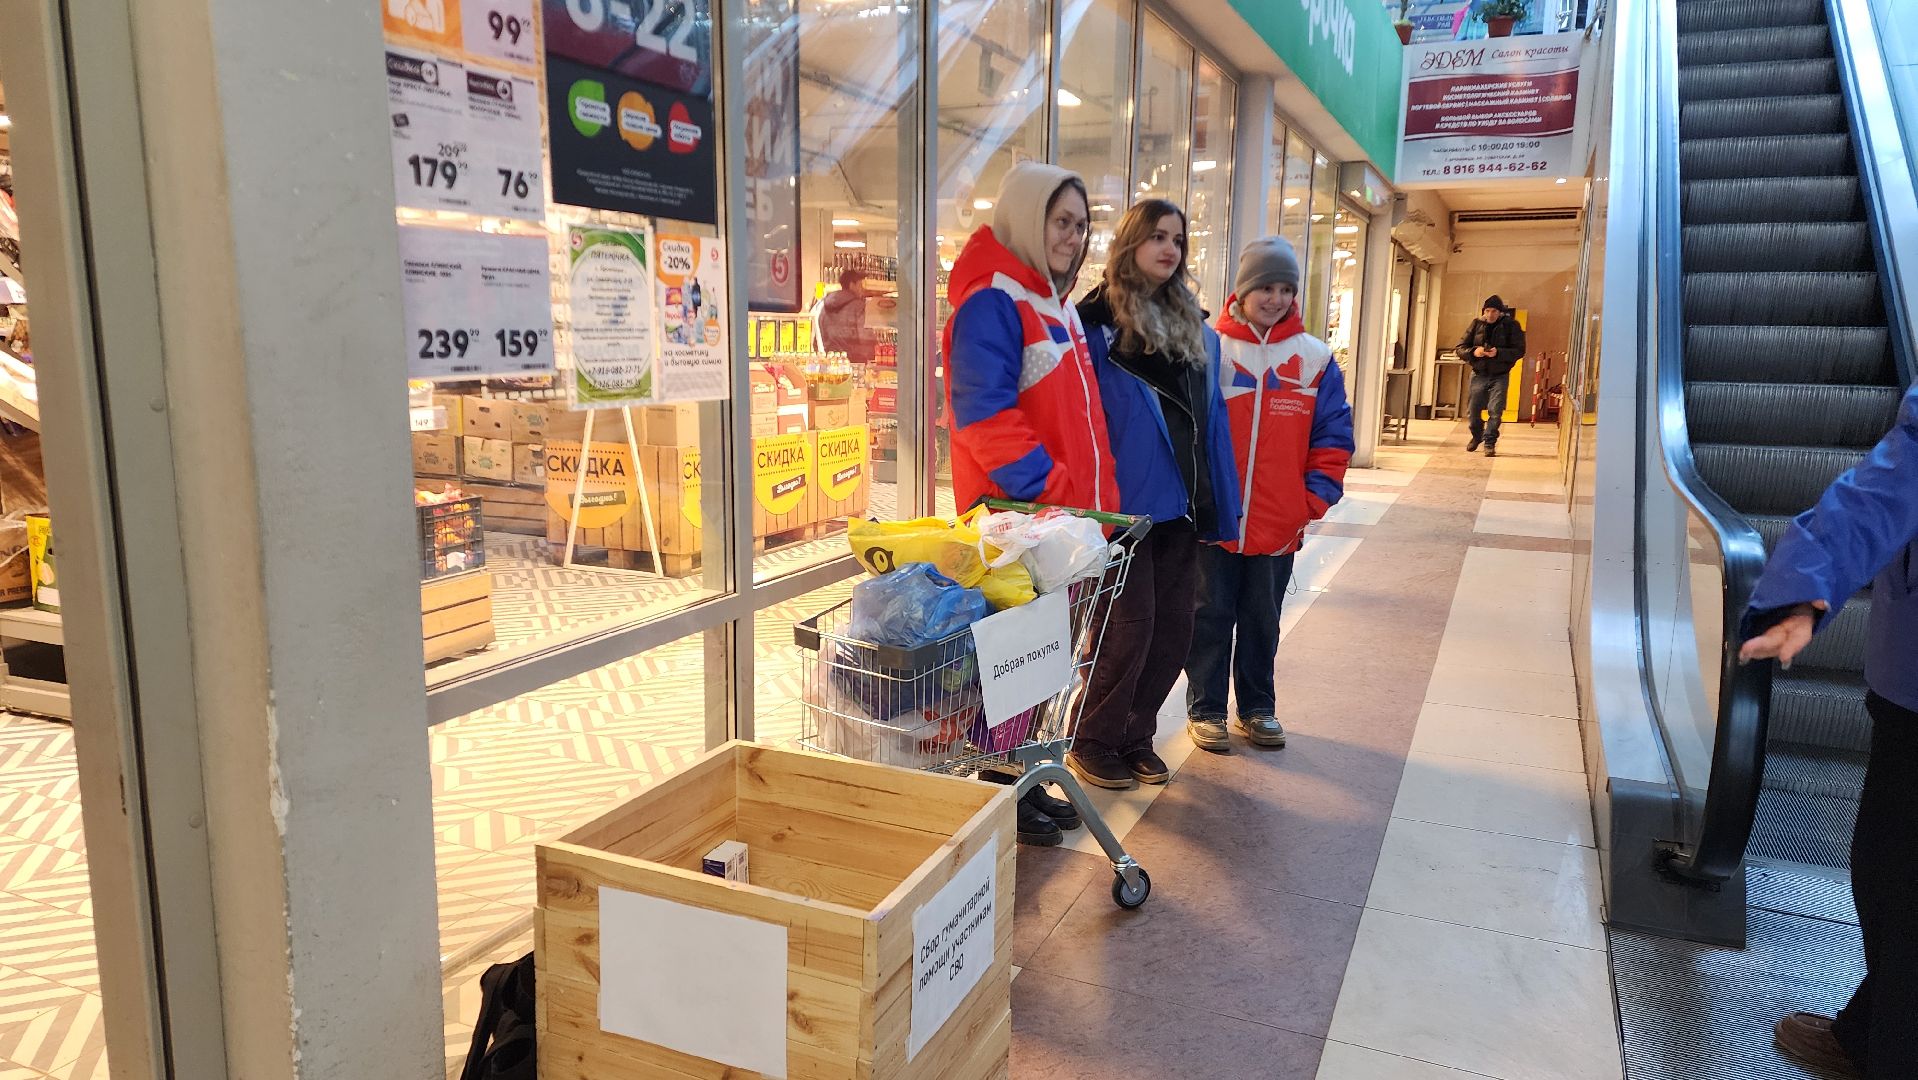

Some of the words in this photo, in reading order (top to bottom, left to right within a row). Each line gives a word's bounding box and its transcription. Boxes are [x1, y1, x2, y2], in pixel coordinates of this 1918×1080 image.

[488, 10, 521, 45] 99
[1301, 0, 1355, 76] рочка
[1420, 48, 1485, 71] ЭДЕМ
[1491, 49, 1521, 60] Салон
[1525, 45, 1569, 58] красоты
[1502, 142, 1514, 150] ДО
[408, 154, 458, 190] 179
[497, 167, 529, 199] 76
[1443, 166, 1450, 175] 8
[1454, 164, 1475, 174] 916
[1478, 161, 1547, 173] 944-62-62
[662, 241, 690, 254] Скидка
[664, 256, 691, 271] -20%
[418, 328, 469, 359] 239
[495, 328, 538, 357] 159
[757, 446, 804, 468] СКИДКА
[820, 438, 860, 458] СКИДКА
[993, 659, 1025, 681] Добрая
[1026, 640, 1060, 664] покупка
[920, 935, 940, 964] Сбор
[941, 875, 990, 943] гуманитарной
[919, 947, 950, 993] помощи
[951, 900, 992, 959] участникам
[949, 952, 964, 982] СВО
